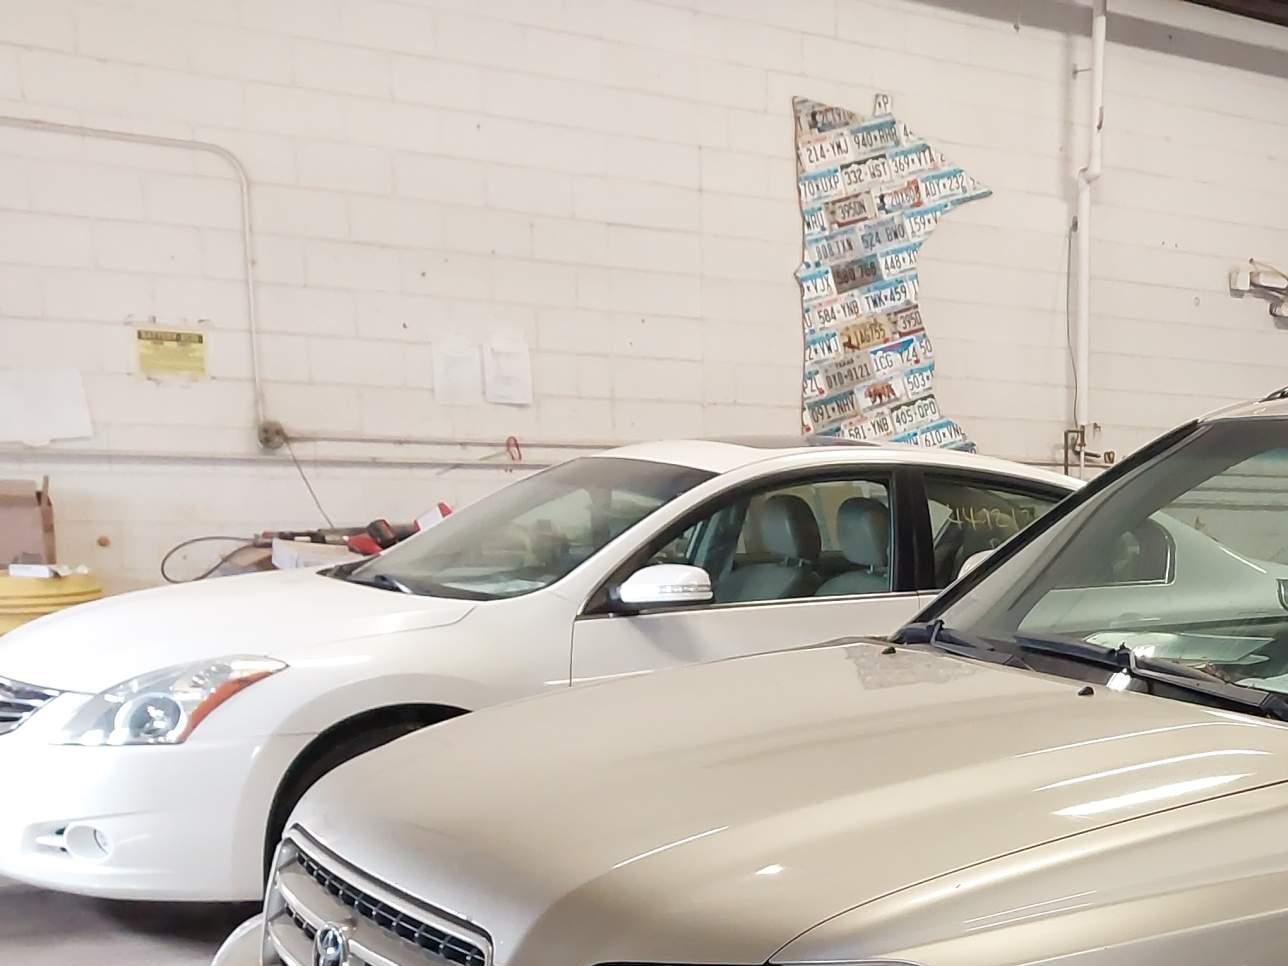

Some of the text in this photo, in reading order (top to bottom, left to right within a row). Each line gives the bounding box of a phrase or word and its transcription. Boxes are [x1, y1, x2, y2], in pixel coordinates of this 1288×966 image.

[853, 131, 873, 149] 940
[820, 174, 840, 193] UXP
[844, 168, 864, 186] 332
[861, 231, 881, 251] 524
[884, 254, 902, 272] 448
[889, 284, 907, 303] 459
[906, 372, 926, 391] 503
[895, 407, 914, 427] 405
[924, 429, 942, 447] 610
